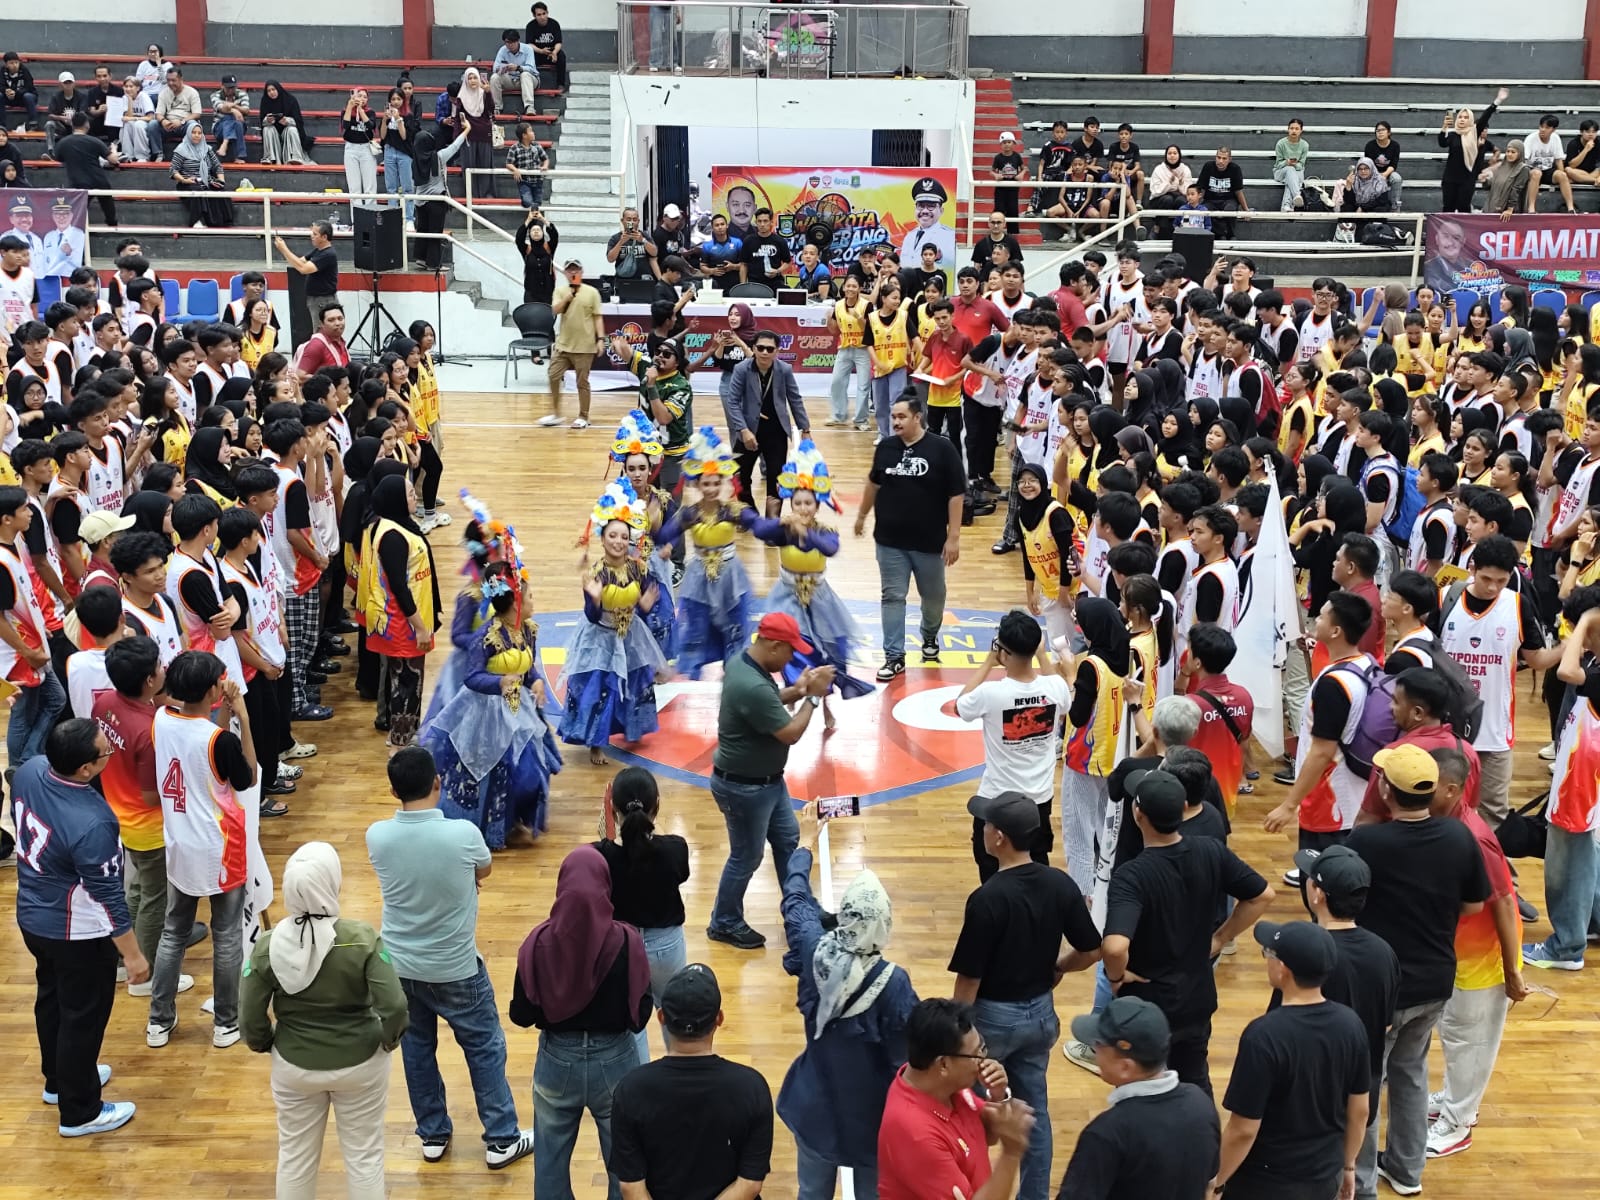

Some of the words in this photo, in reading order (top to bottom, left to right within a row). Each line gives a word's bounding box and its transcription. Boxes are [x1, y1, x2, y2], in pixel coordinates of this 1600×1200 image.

[785, 227, 887, 251] TAERANG
[831, 248, 862, 262] 202
[1041, 562, 1060, 579] 14
[1014, 695, 1047, 707] REVOLT
[1203, 705, 1248, 723] OFCIAL
[162, 757, 187, 814] 4
